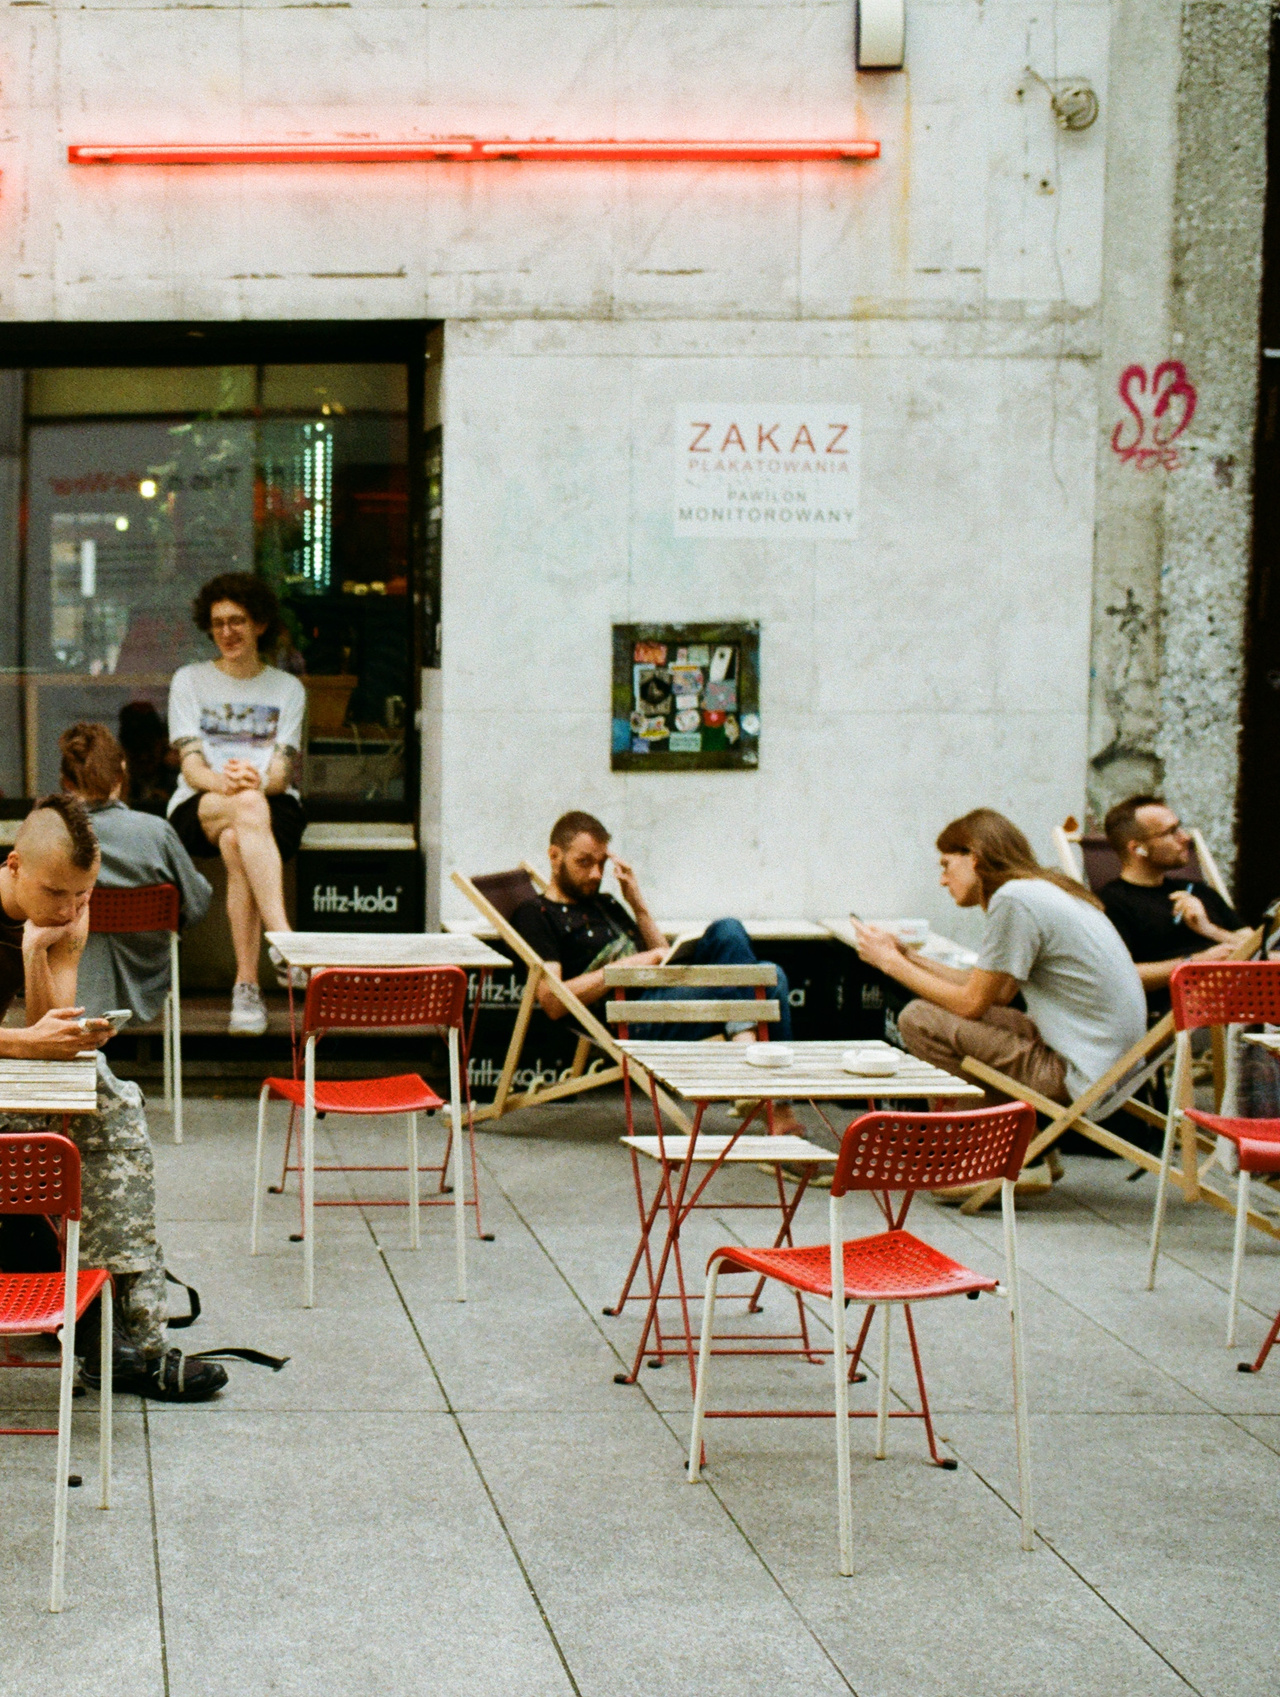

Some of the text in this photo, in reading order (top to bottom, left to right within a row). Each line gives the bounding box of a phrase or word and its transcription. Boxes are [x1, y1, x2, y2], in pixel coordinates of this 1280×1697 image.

[688, 422, 850, 454] ZAKAZ
[687, 458, 849, 474] PLAKATOWANIA
[677, 507, 853, 523] MONITOROWANY
[312, 885, 399, 913] fritz-kola
